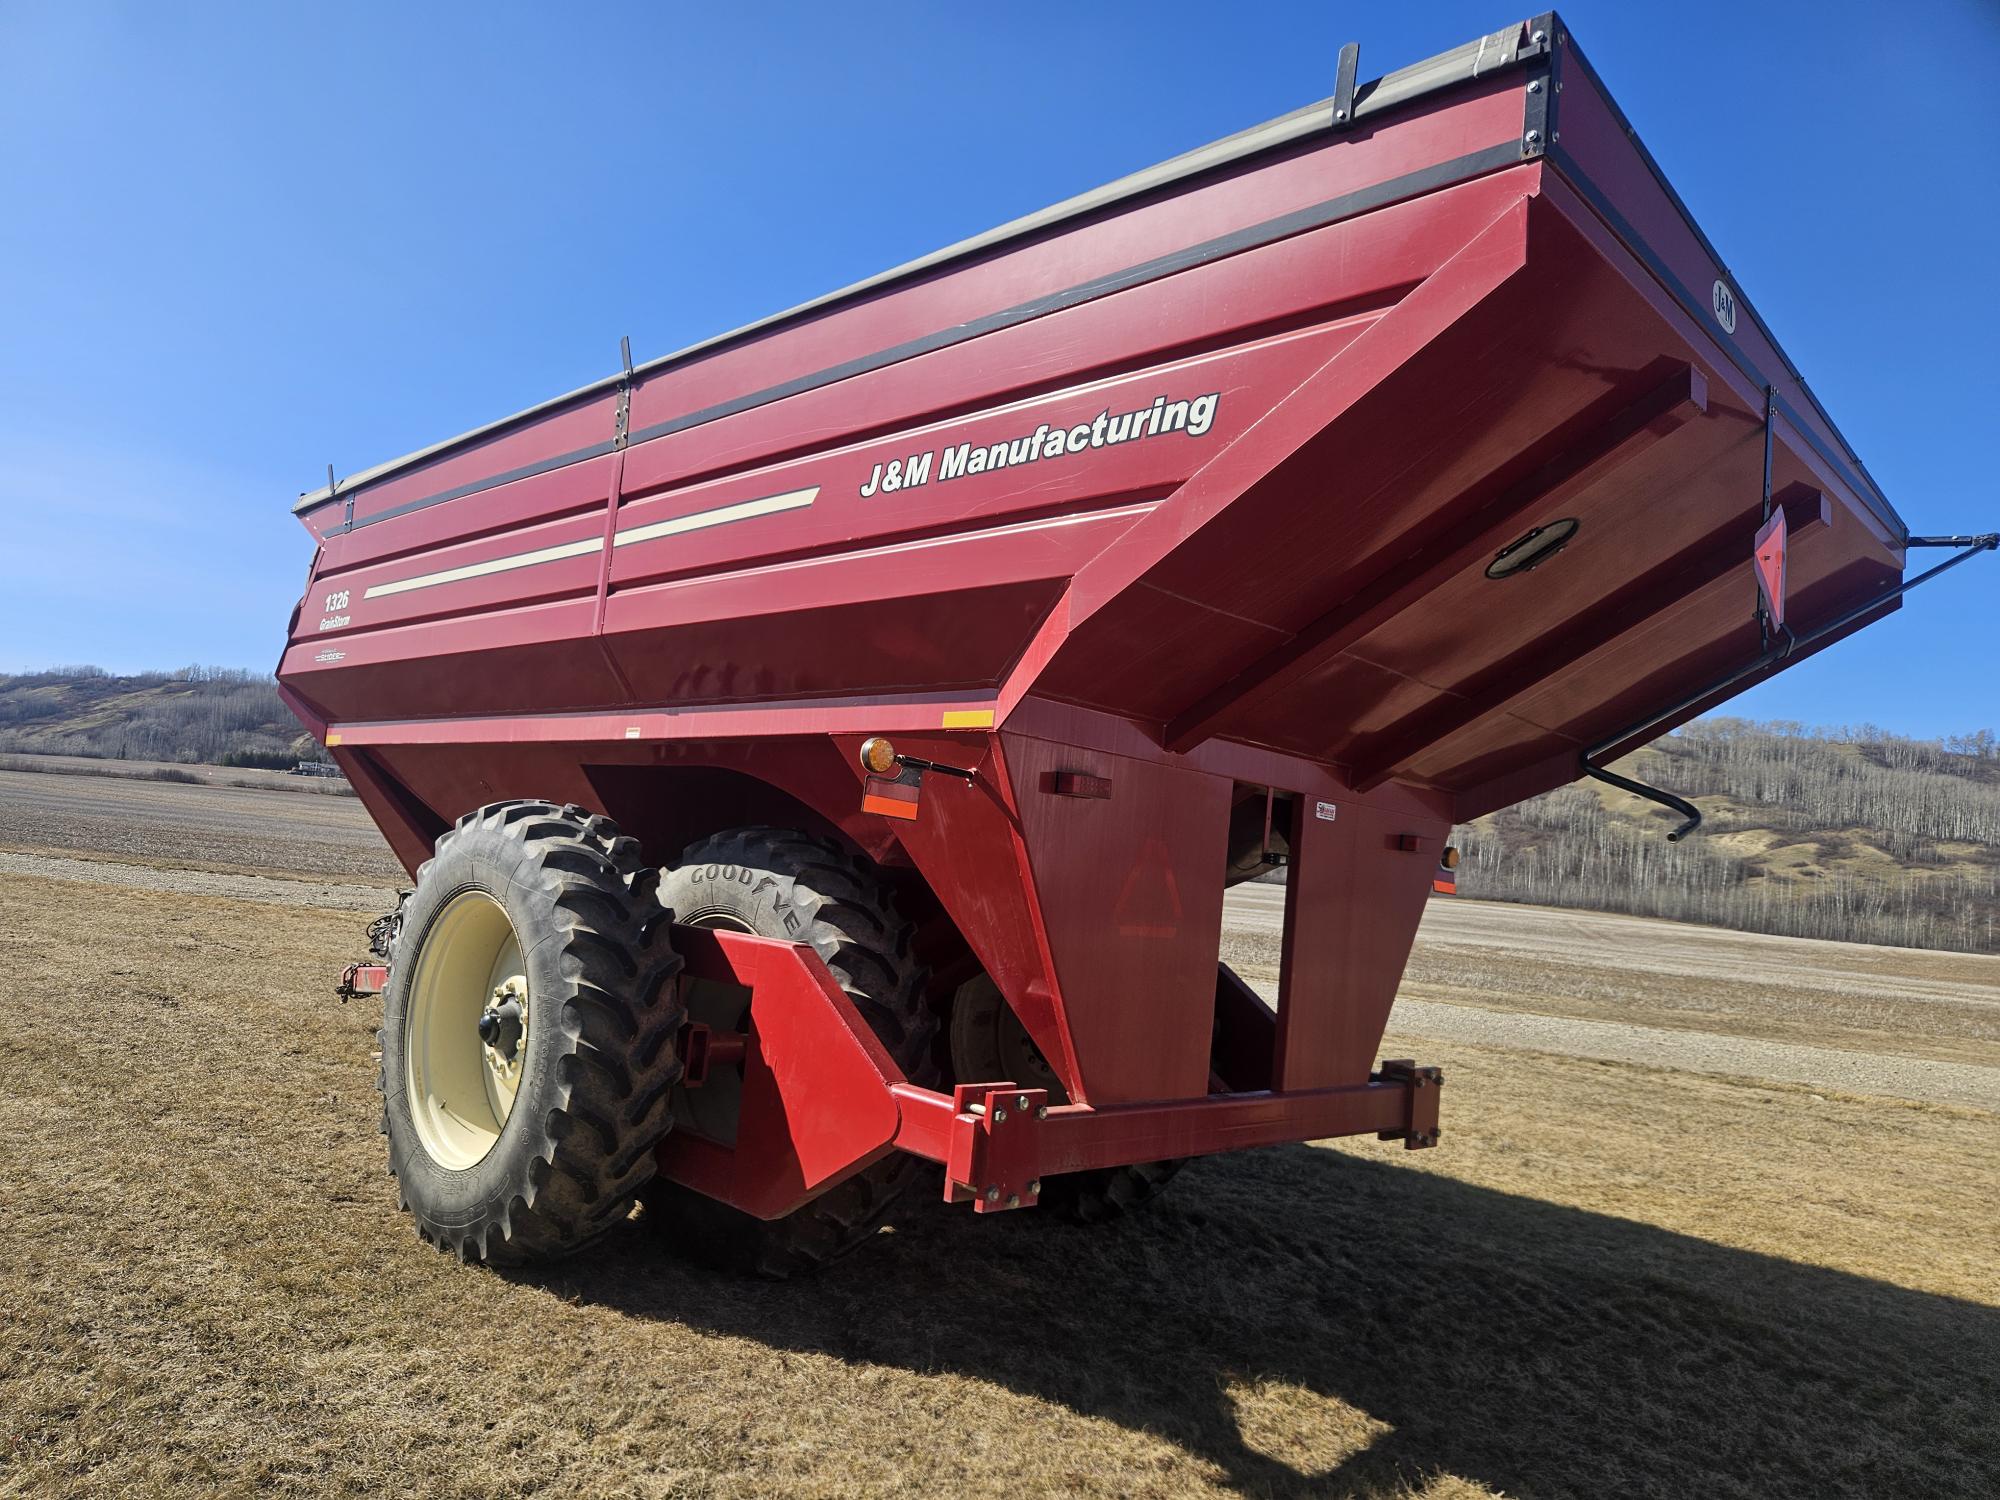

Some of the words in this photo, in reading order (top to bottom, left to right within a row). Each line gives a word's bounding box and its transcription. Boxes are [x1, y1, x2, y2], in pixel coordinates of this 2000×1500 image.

[1715, 284, 1733, 327] J&M
[859, 450, 934, 498] J&M
[937, 391, 1221, 480] Manufacturing
[325, 590, 350, 612] 1326
[691, 863, 802, 937] GOODYE
